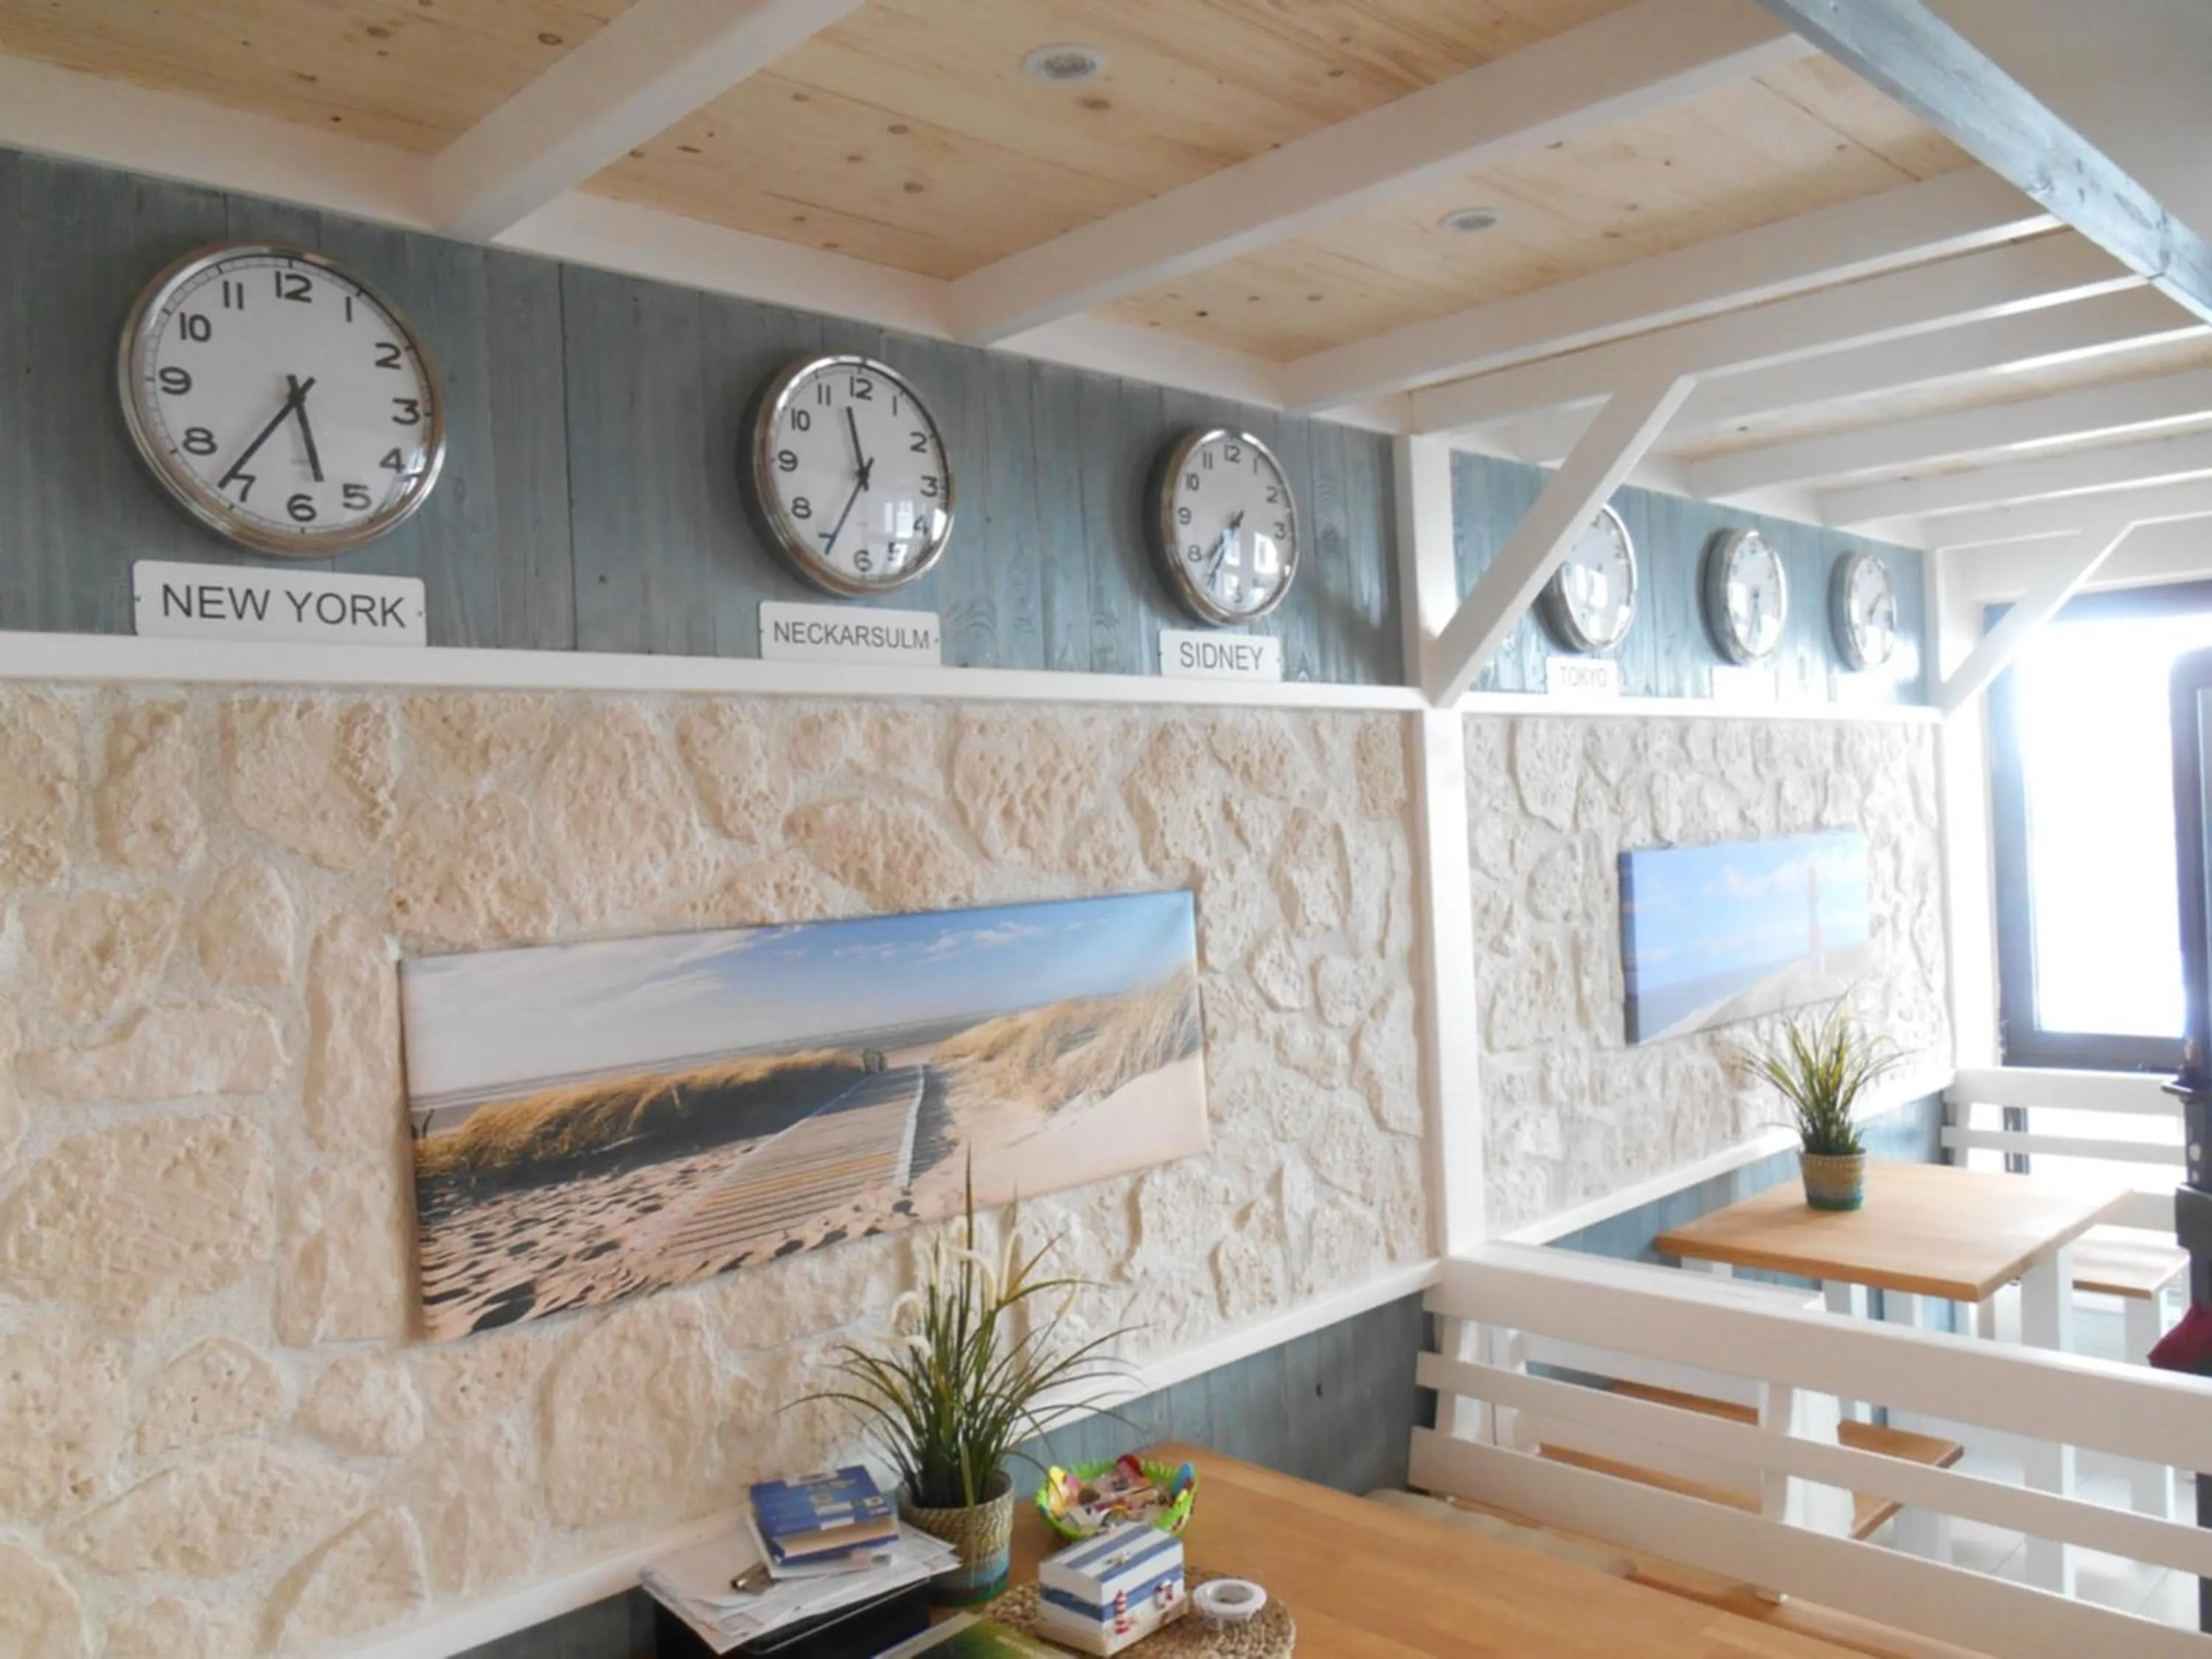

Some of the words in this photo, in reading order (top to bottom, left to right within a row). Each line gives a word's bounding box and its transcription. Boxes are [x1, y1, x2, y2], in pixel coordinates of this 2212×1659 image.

[223, 281, 243, 310] 11
[275, 271, 312, 303] 12
[180, 312, 211, 342] 10
[375, 342, 401, 369] 2
[159, 366, 192, 395] 9
[849, 376, 873, 400] 12
[817, 384, 830, 407] 11
[392, 397, 420, 425] 3
[790, 408, 810, 432] 10
[181, 427, 218, 456] 8
[910, 431, 928, 453] 2
[379, 448, 406, 473] 4
[778, 449, 798, 472] 9
[1203, 451, 1213, 470] 11
[1224, 445, 1241, 463] 12
[229, 473, 256, 502] 7
[920, 475, 938, 498] 3
[1186, 473, 1200, 491] 10
[287, 493, 316, 522] 6
[342, 483, 372, 511] 5
[1266, 487, 1279, 504] 2
[792, 497, 812, 519] 8
[1178, 507, 1192, 524] 9
[913, 515, 929, 536] 4
[1274, 522, 1286, 540] 3
[854, 550, 872, 572] 6
[1188, 545, 1202, 563] 8
[161, 582, 270, 622] NEW
[284, 590, 406, 628] YORK
[773, 620, 930, 650] NECKARSULM
[1179, 641, 1263, 670] SIDNEY
[1559, 666, 1607, 687] TOKYO
